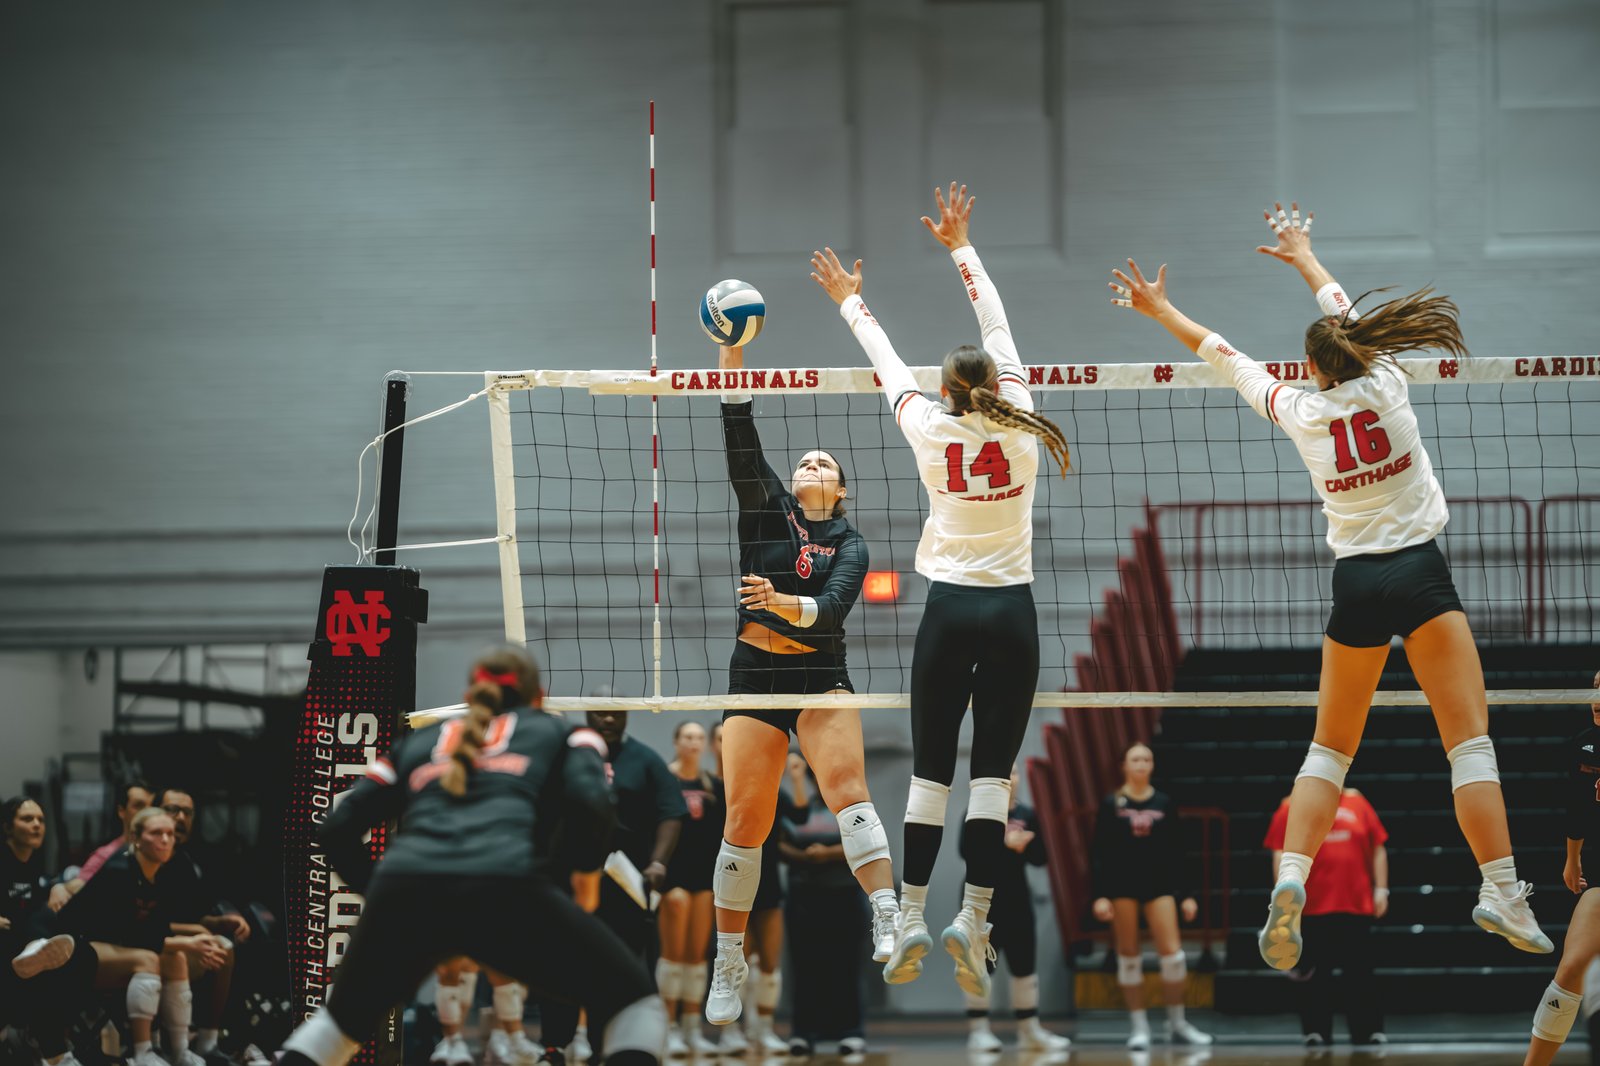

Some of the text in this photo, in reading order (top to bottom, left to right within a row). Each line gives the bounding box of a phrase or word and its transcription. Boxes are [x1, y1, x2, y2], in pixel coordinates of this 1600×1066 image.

[969, 287, 979, 302] ON
[671, 369, 819, 390] CARDINALS
[1515, 356, 1600, 377] CARDI
[1329, 408, 1392, 473] 16
[944, 440, 1011, 492] 14
[1325, 451, 1412, 493] CARTHAGE
[796, 544, 814, 579] 6
[307, 842, 327, 950] CENTRA
